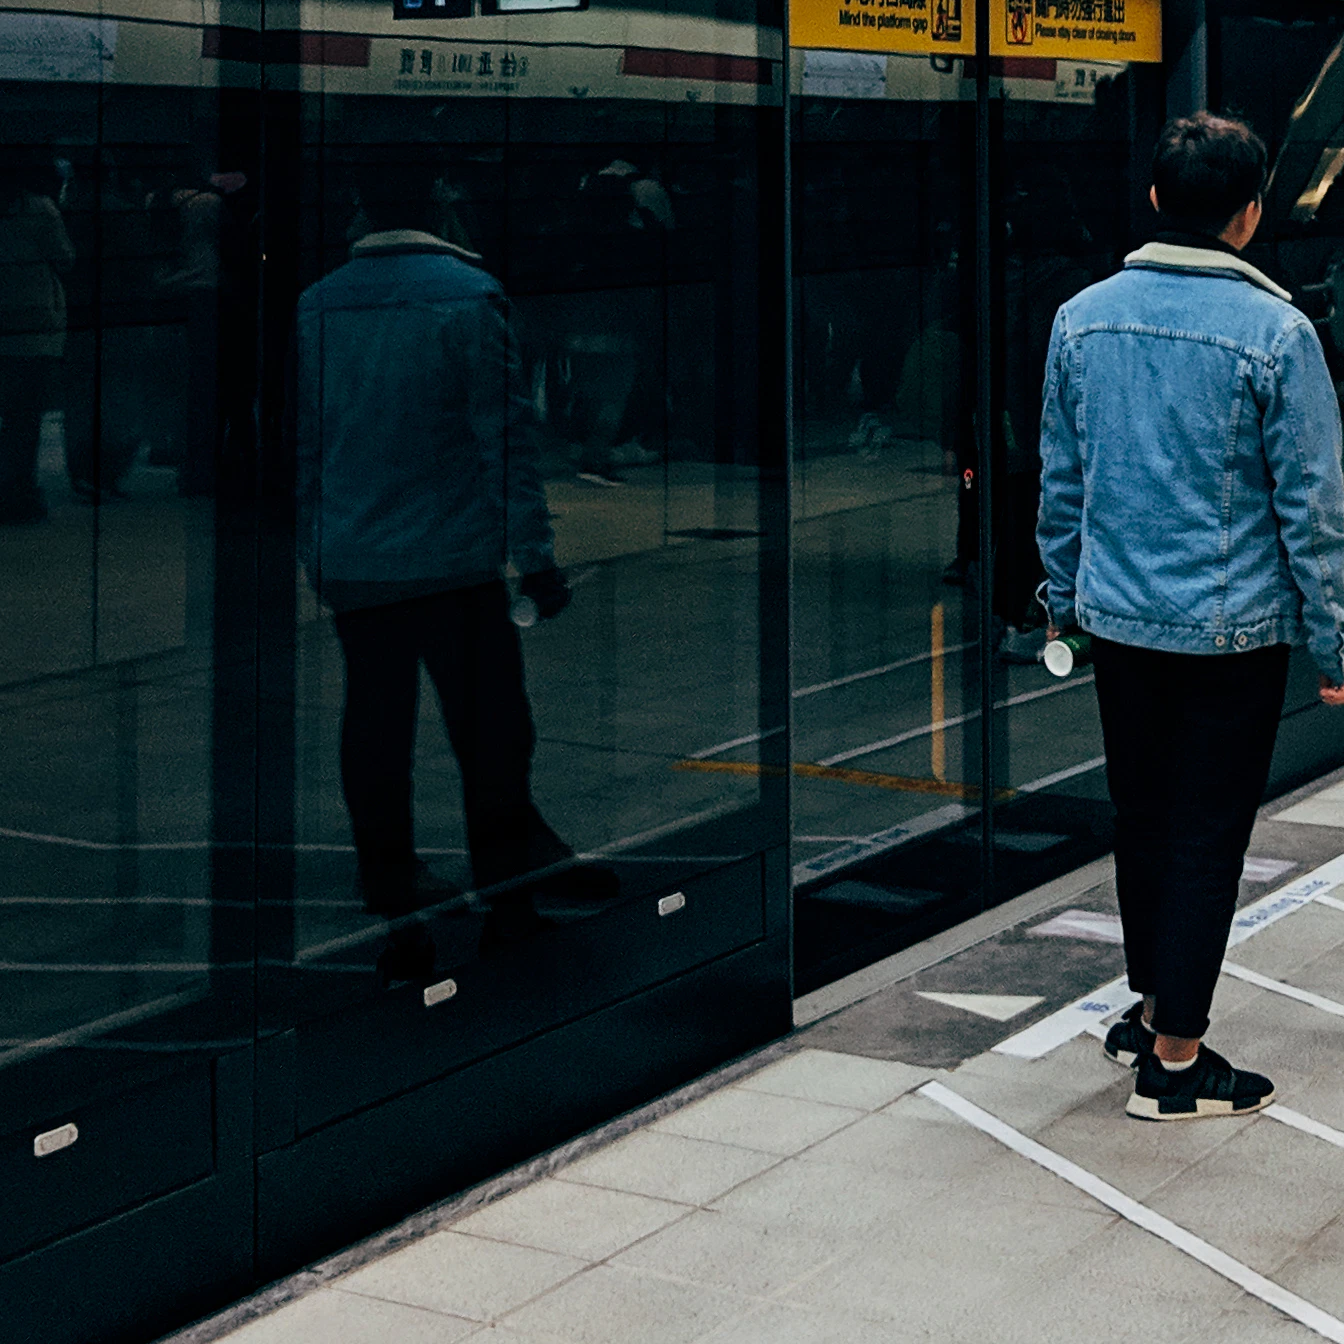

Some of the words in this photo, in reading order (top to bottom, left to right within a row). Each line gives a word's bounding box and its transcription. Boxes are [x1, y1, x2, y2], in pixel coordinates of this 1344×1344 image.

[839, 9, 860, 25] Mind
[862, 12, 876, 27] the
[878, 13, 911, 31] platform
[912, 18, 928, 34] gap
